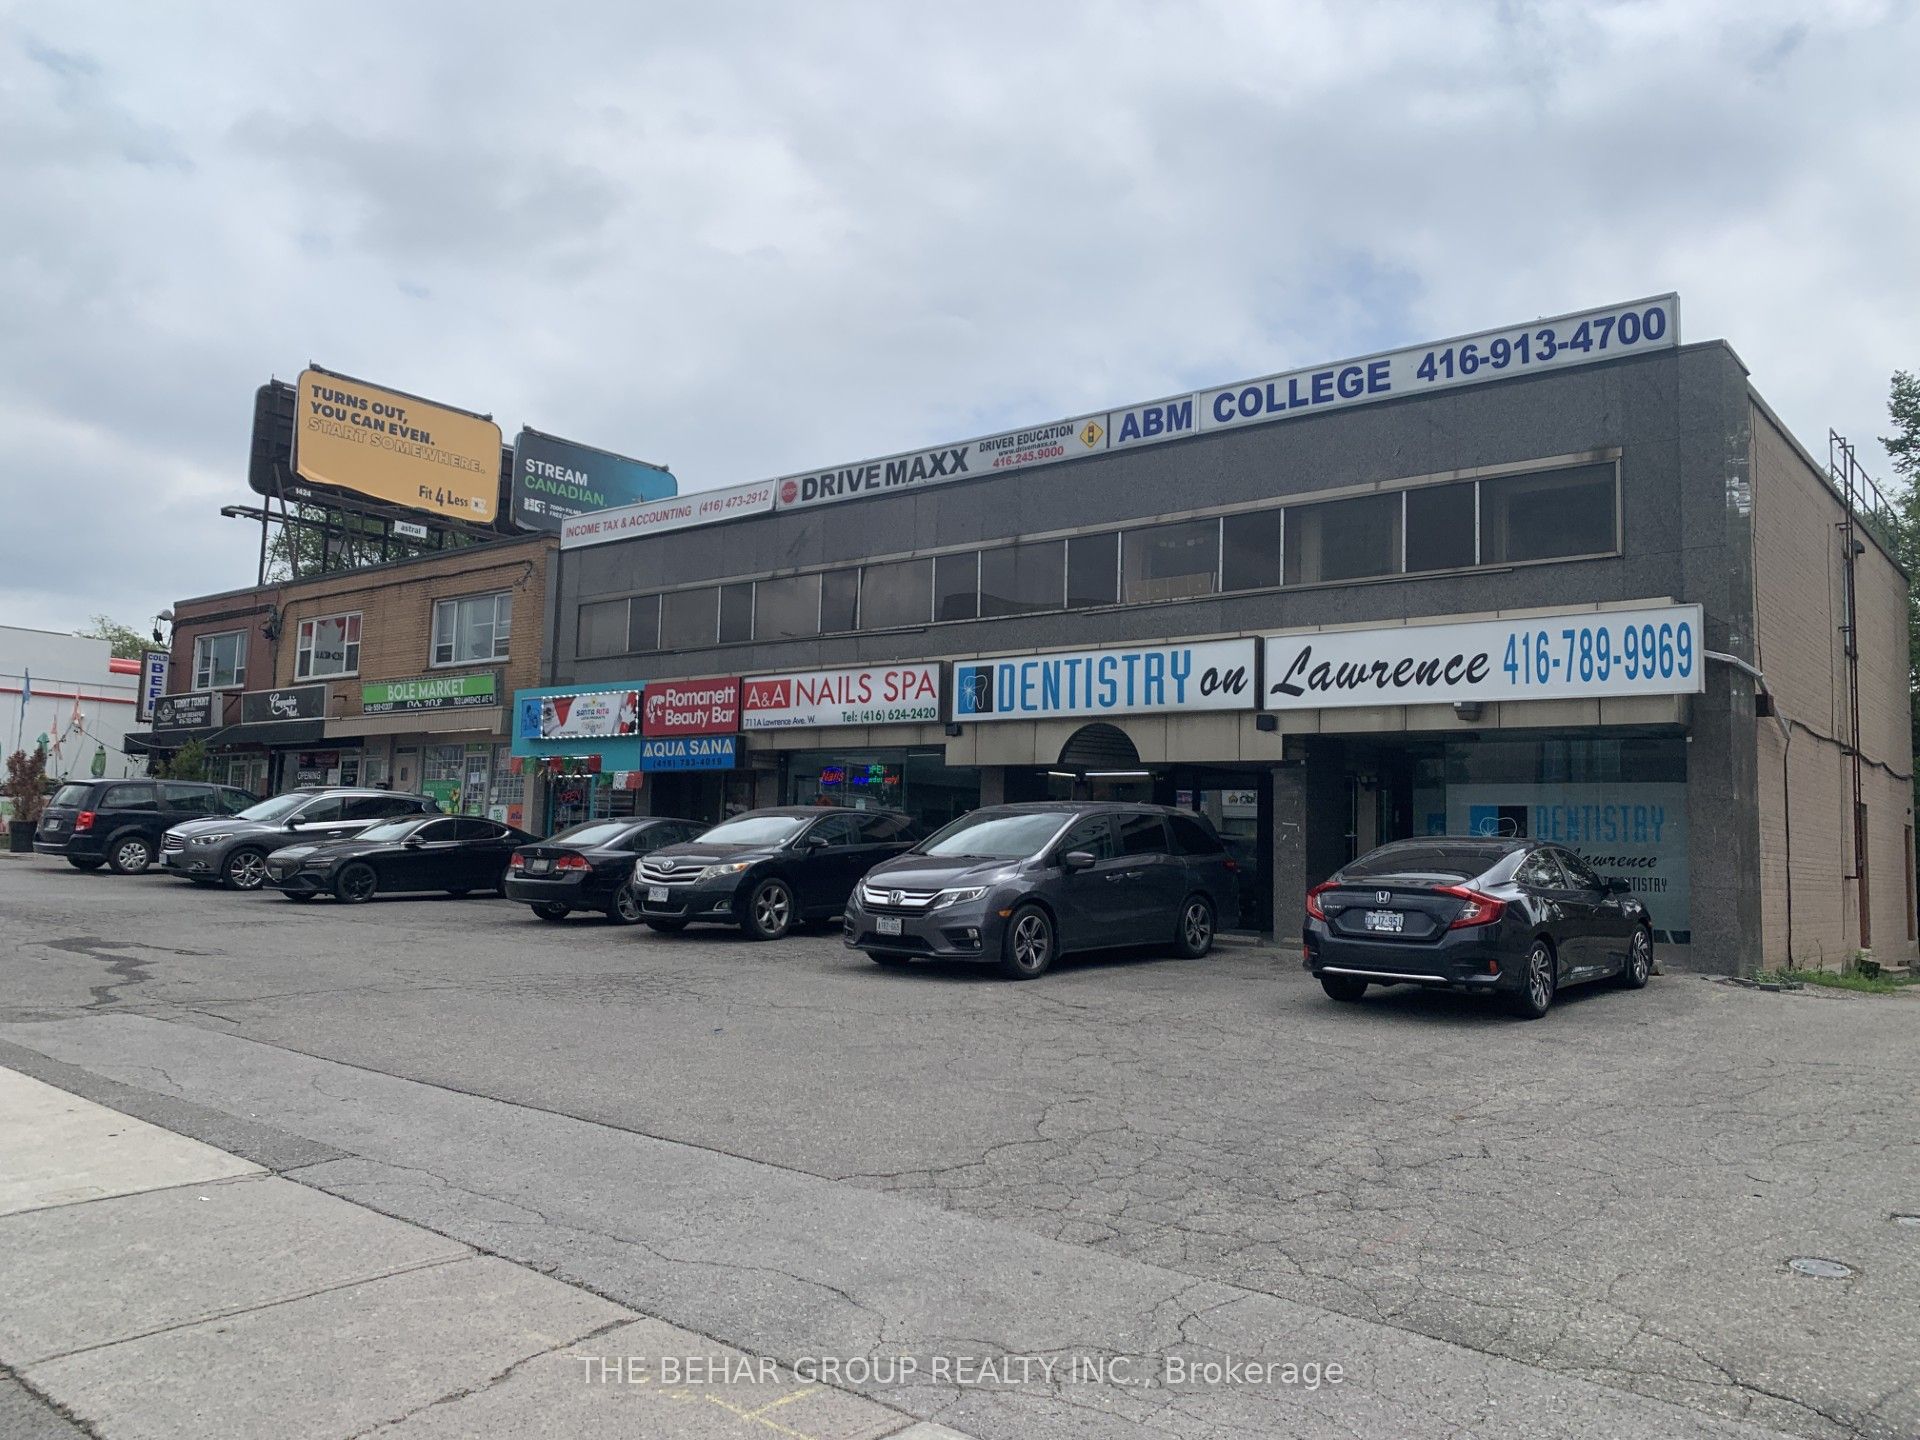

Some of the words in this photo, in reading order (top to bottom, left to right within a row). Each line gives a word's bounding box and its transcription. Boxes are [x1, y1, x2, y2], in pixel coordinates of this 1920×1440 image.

[1118, 400, 1193, 443] ABM
[1213, 360, 1392, 424] COLLEGE
[1416, 306, 1667, 383] 416-913-4700
[312, 385, 368, 410] TURNS
[372, 402, 408, 424] OUT,
[311, 401, 347, 422] YOU
[351, 413, 385, 432] CAN
[388, 423, 436, 446] EVEN.
[308, 417, 367, 443] START
[370, 433, 486, 474] SOMEWHERE.
[979, 436, 1014, 453] DRIVER
[1017, 424, 1074, 446] EDUCATION
[999, 440, 1057, 457] www.drivemaxx.ca
[992, 446, 1064, 468] 416.245.9000
[525, 459, 588, 486] STREAM
[295, 487, 312, 498] 1424
[419, 486, 433, 500] Fit
[435, 487, 444, 506] 4
[447, 491, 468, 507] Less
[524, 475, 608, 507] CANADIAN.
[566, 522, 601, 538] INCOME
[603, 519, 618, 532] TAX
[621, 518, 627, 528] &
[629, 505, 692, 528] ACCOUNTING
[699, 497, 724, 516] (416)
[726, 489, 769, 510] 473-2912
[401, 524, 421, 535] astral
[148, 654, 168, 662] COLD
[998, 649, 1191, 713] DENTISTRY
[1200, 664, 1249, 696] on
[1270, 645, 1491, 697] Lawrence
[1503, 621, 1692, 686] 416-789-9969
[387, 682, 416, 701] BOLE
[418, 678, 465, 698] MARKET
[665, 686, 736, 707] Romanett
[746, 684, 787, 708] A&A
[796, 673, 873, 707] NAILS
[883, 670, 937, 702] SPA
[665, 709, 709, 728] Beauty
[712, 707, 735, 724] Bar
[745, 717, 762, 727] 711A
[763, 717, 791, 727] Lawrence
[842, 711, 858, 723] Tel:
[860, 709, 886, 723] (416)
[888, 707, 937, 721] 624-2420
[643, 741, 686, 757] AQUA
[689, 739, 733, 755] SANA
[298, 771, 320, 780] OPENING
[1536, 805, 1665, 842] DENTISTRY
[1572, 848, 1657, 869] awrence
